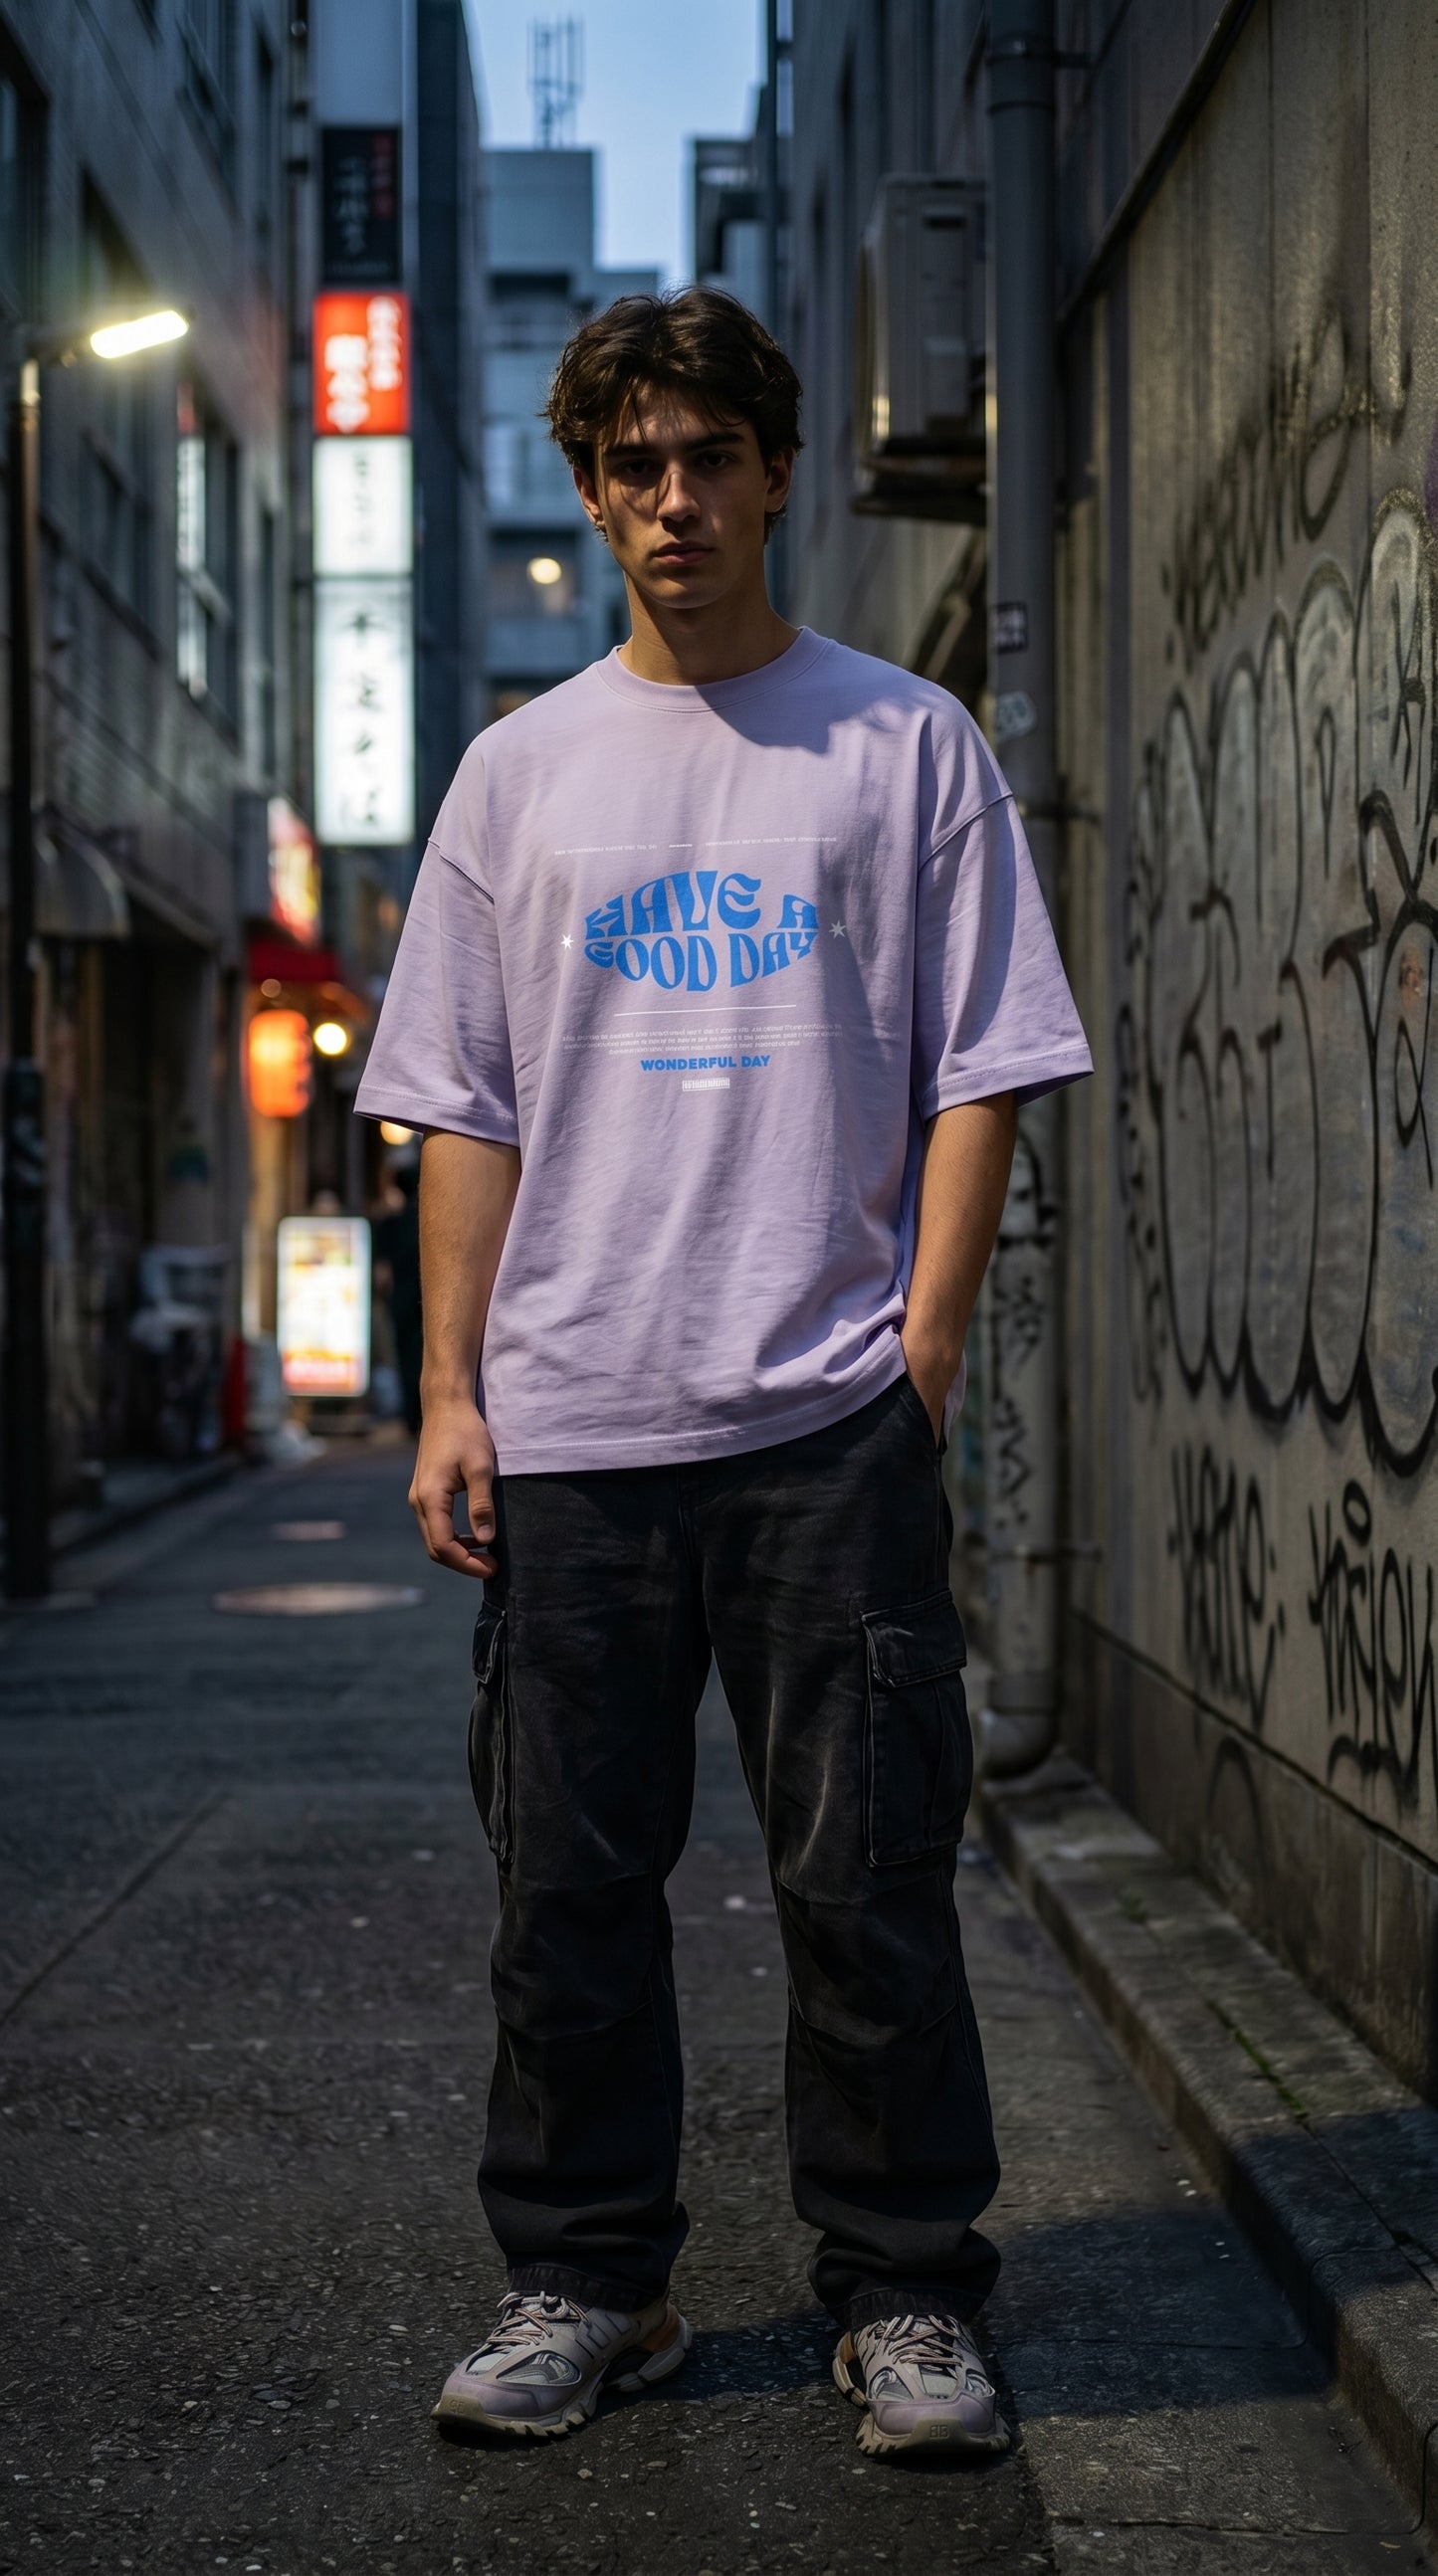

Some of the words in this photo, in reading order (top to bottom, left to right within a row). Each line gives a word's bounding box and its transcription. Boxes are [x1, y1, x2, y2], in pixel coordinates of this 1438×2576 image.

[584, 870, 762, 939] HAVE
[777, 893, 819, 930] A
[583, 933, 718, 993] GOOD
[728, 928, 819, 988] DAY
[640, 1056, 736, 1072] WONDERFUL
[740, 1055, 770, 1069] DAY
